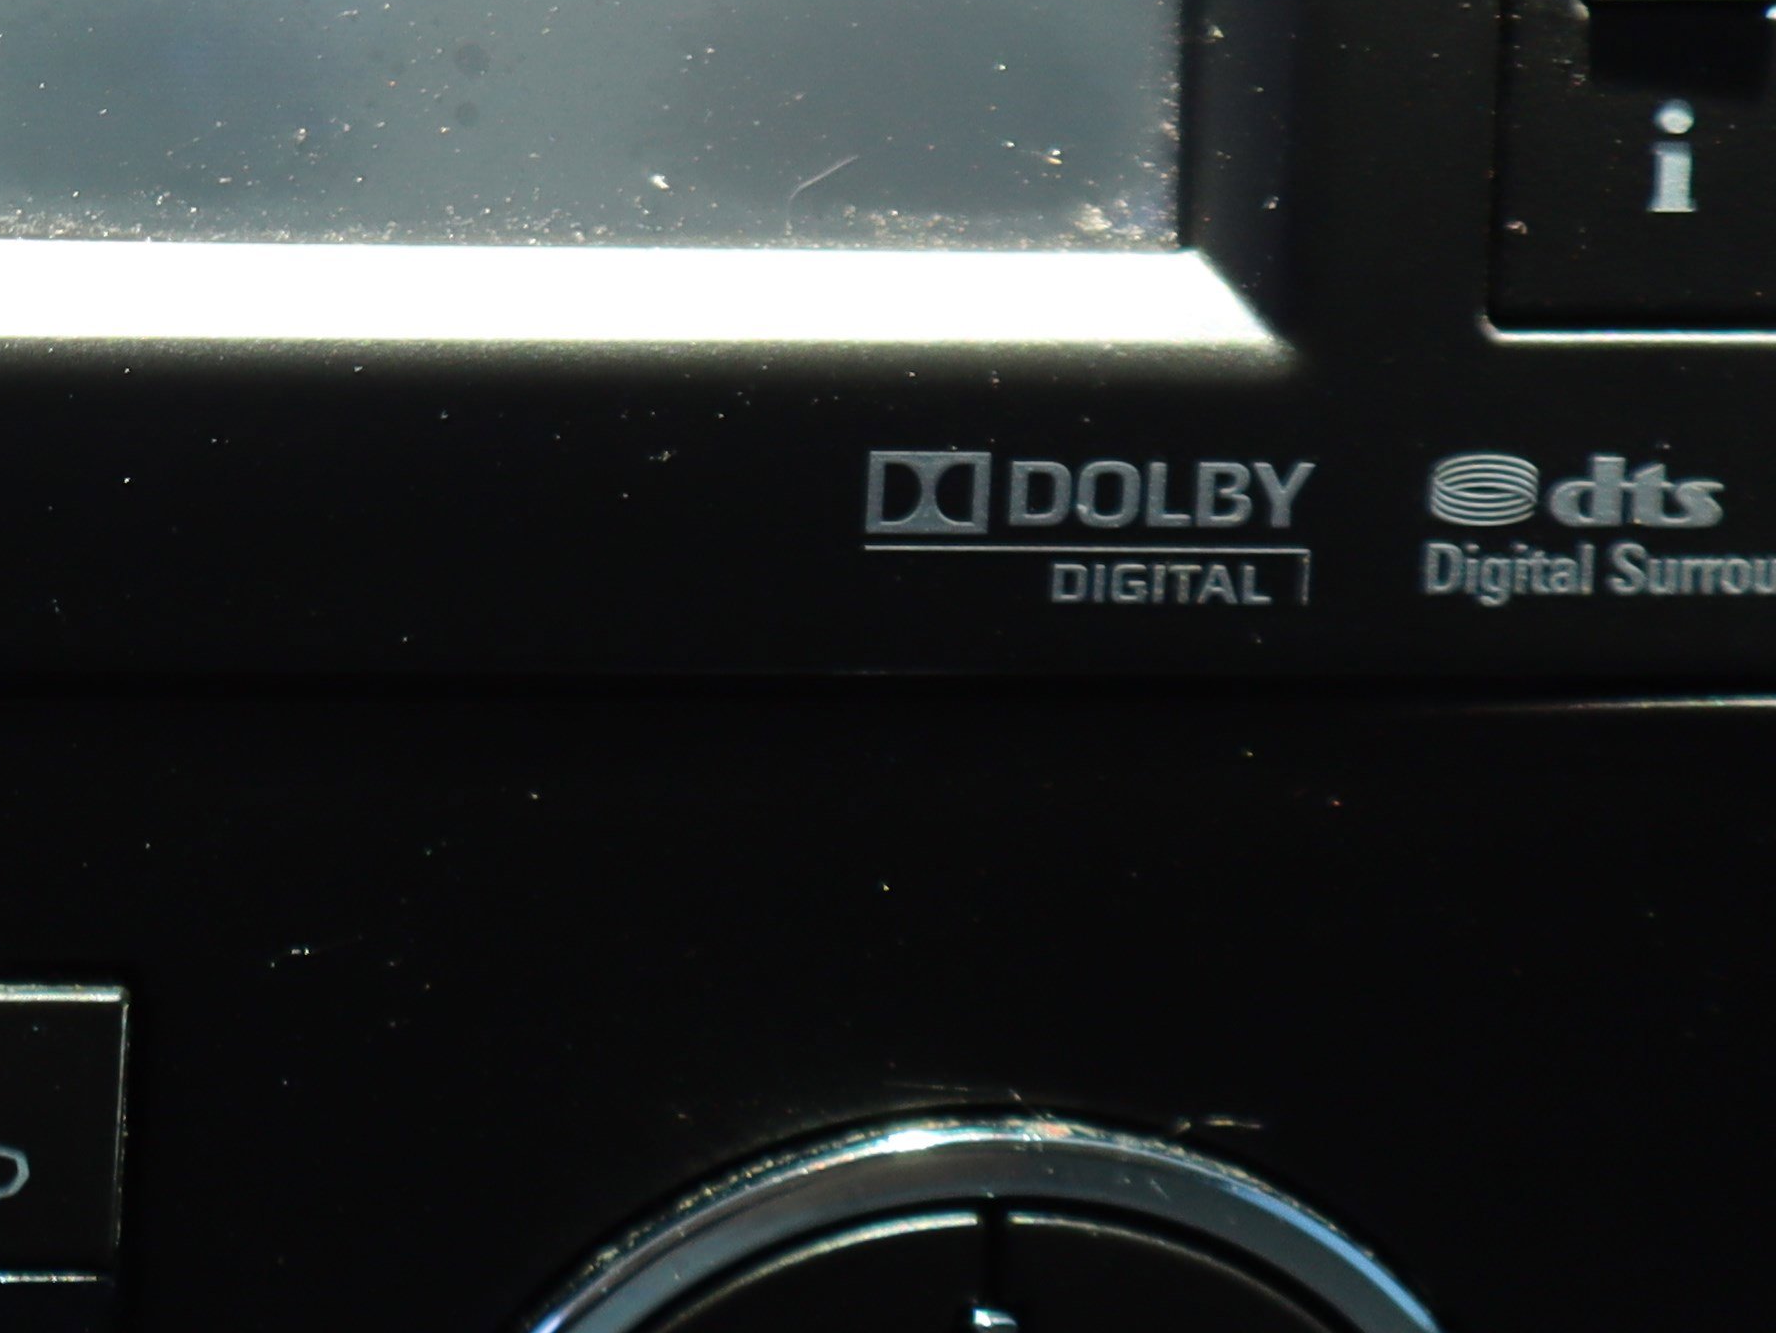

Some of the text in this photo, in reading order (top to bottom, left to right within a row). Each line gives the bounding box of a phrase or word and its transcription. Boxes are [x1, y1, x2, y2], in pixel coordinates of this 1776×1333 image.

[1008, 458, 1317, 529] DOLBY
[1548, 453, 1726, 528] dts
[1050, 561, 1273, 605] DIGITAL
[1422, 540, 1596, 607] Digital
